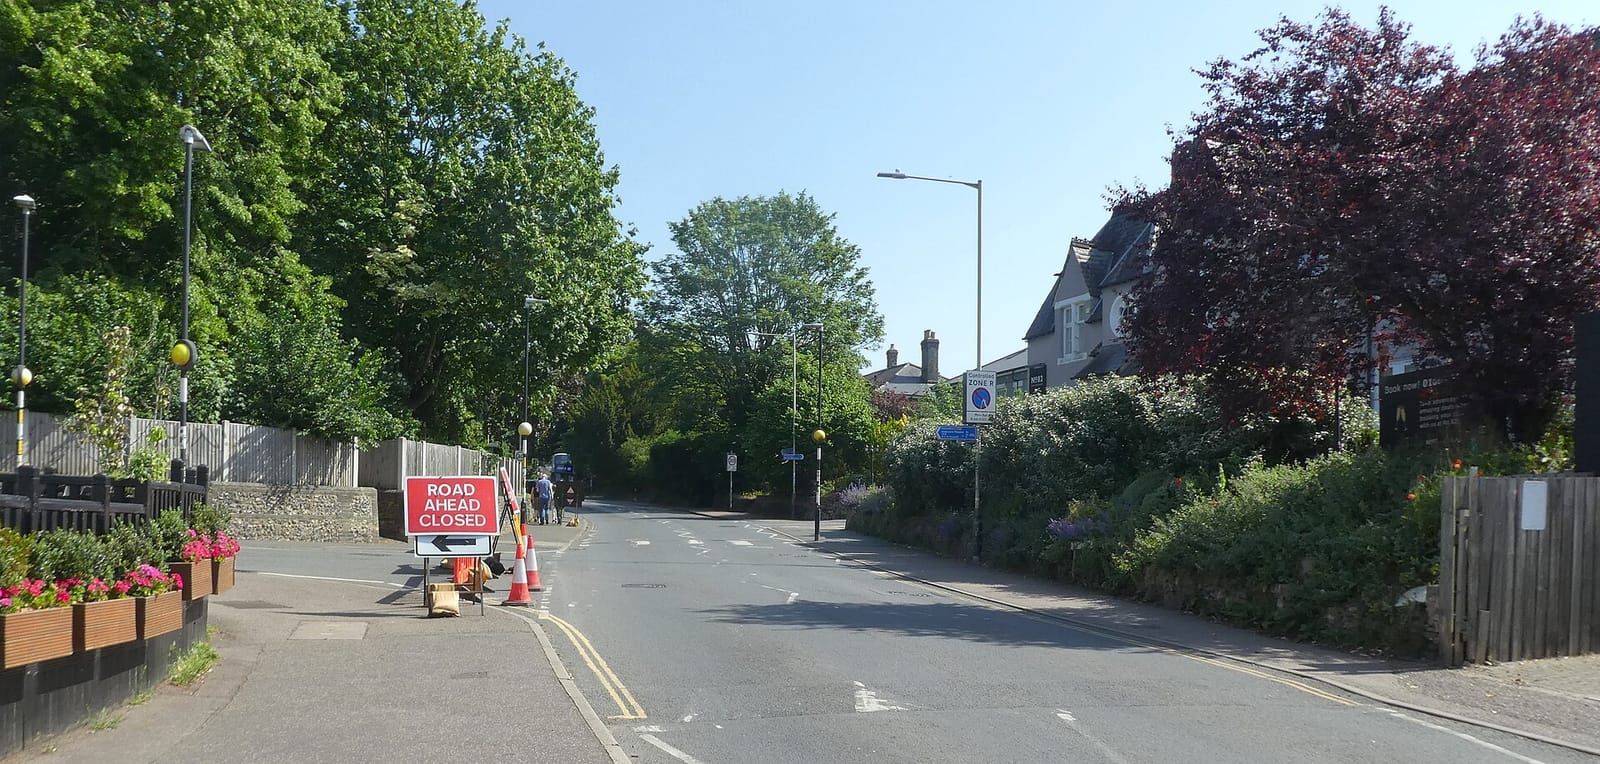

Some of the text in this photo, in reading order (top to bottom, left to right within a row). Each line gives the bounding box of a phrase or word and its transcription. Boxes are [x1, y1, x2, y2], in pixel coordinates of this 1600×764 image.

[427, 483, 475, 497] ROAD
[424, 498, 481, 512] AHEAD
[419, 513, 486, 527] CLOSED
